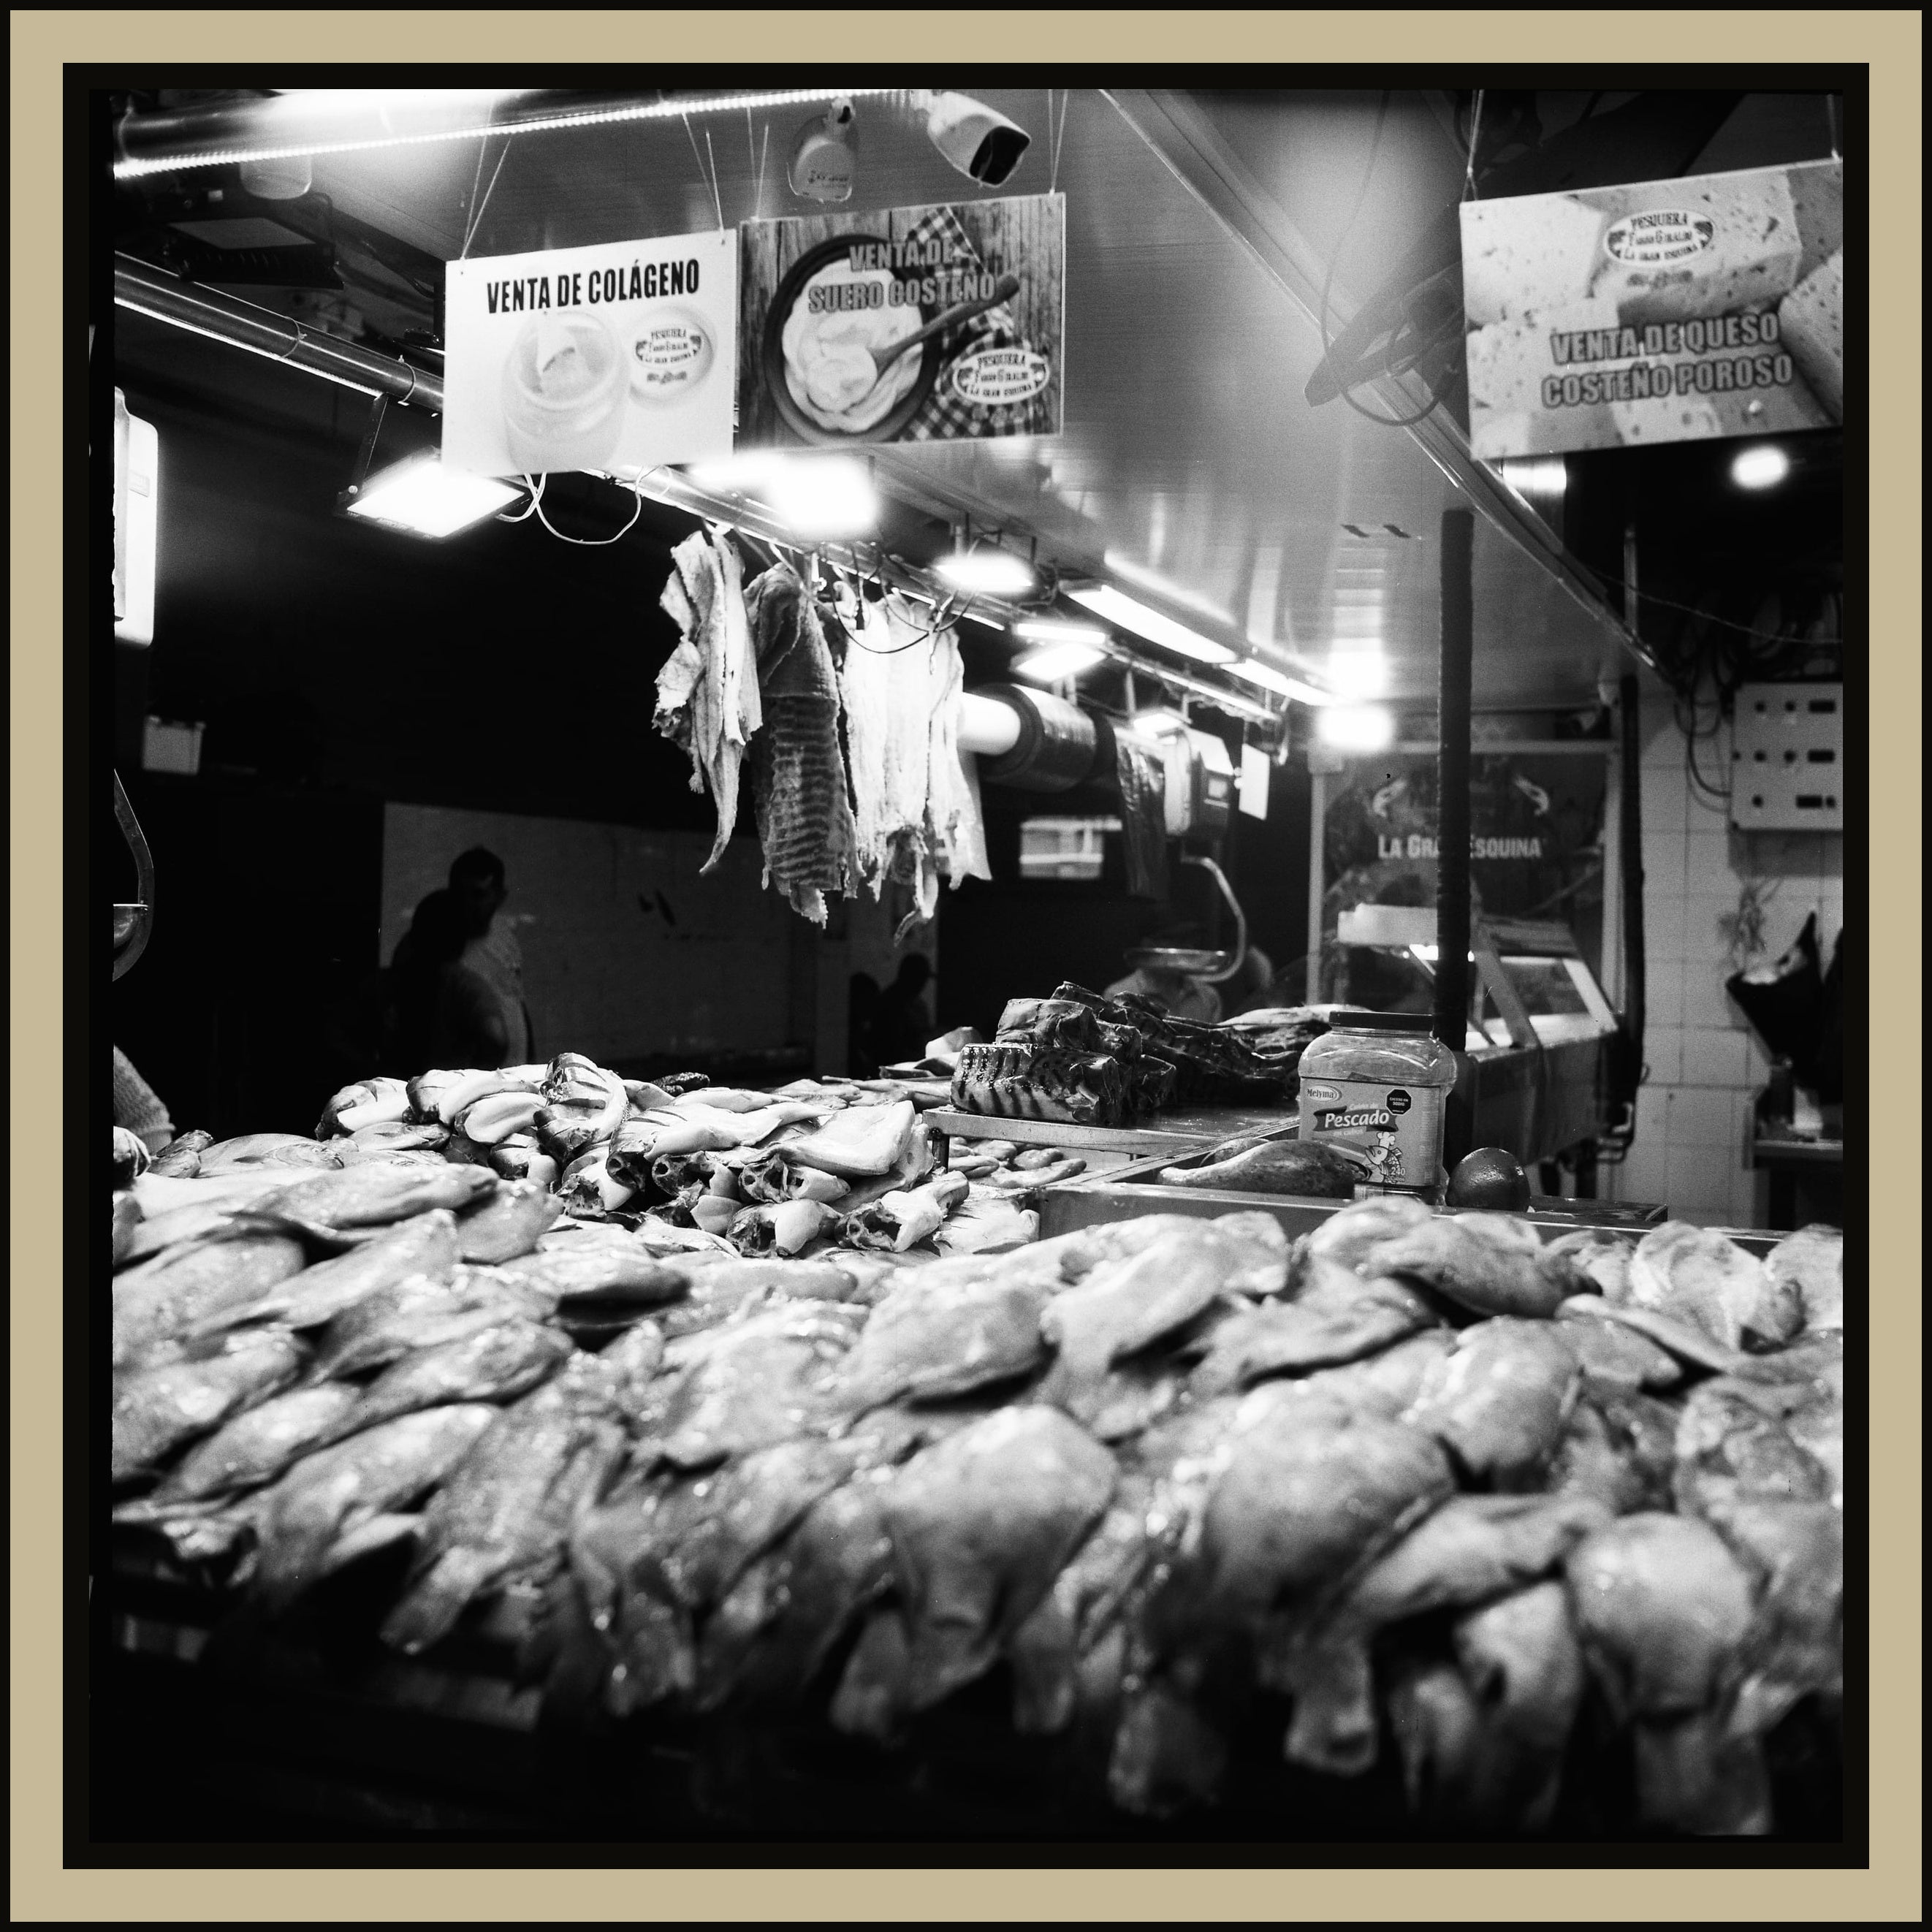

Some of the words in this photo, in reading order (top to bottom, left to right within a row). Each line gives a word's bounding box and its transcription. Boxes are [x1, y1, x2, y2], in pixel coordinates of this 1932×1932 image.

[849, 239, 920, 272] VENTA
[927, 237, 953, 266] DE
[487, 275, 550, 314] VENTA
[558, 273, 582, 308] DE
[588, 259, 699, 304] COLÁGENO
[808, 281, 884, 314] SUERO
[1550, 328, 1641, 366] VENTA
[1644, 322, 1681, 356] DE
[1684, 312, 1779, 355] QUESO
[1540, 362, 1672, 409] COSTEÑO
[1675, 353, 1792, 396] POROSO
[1378, 834, 1402, 859] LA
[1307, 1088, 1334, 1098] Melyma
[1325, 1109, 1390, 1128] Pescado
[1391, 1166, 1405, 1176] 240
